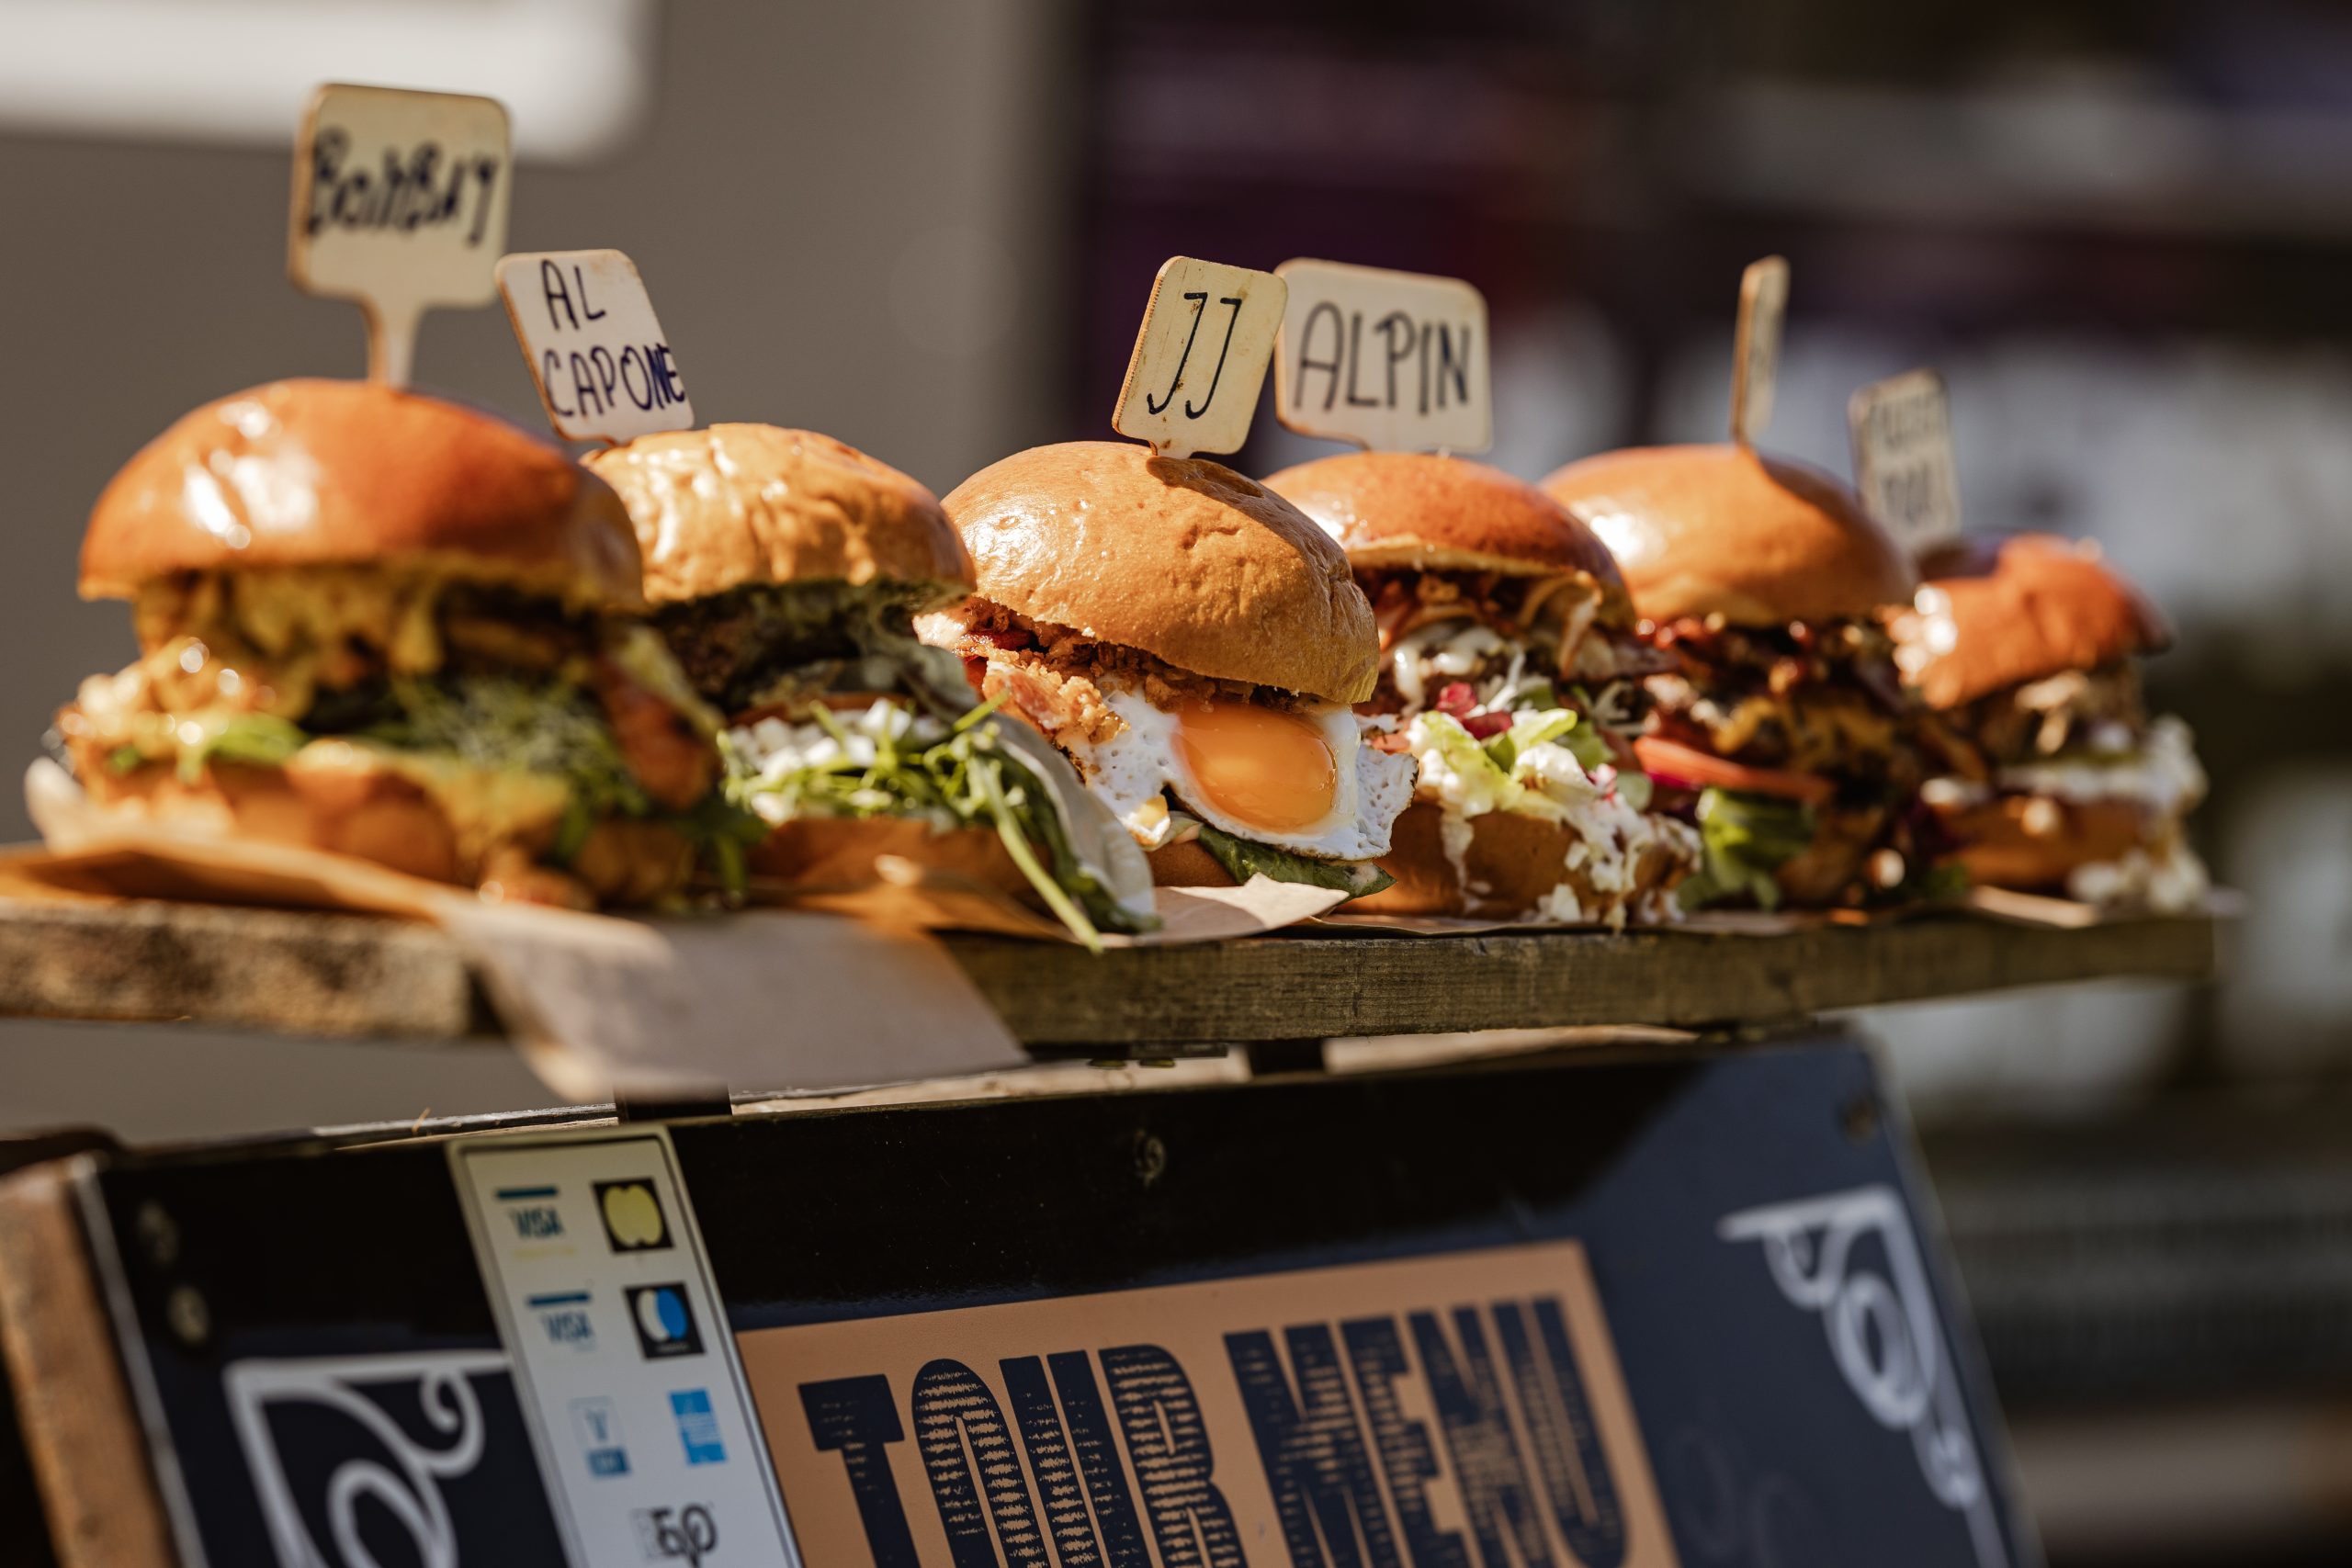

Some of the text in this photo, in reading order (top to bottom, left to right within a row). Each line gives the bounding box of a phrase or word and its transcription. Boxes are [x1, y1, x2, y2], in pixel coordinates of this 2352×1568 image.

[539, 258, 607, 332] AL
[544, 344, 686, 419] CAPONE
[1146, 291, 1243, 420] JJ
[1292, 300, 1471, 416] ALPIN
[509, 1205, 565, 1239] VISA
[542, 1311, 593, 1344] VISA
[1223, 1298, 1631, 1568] MENU
